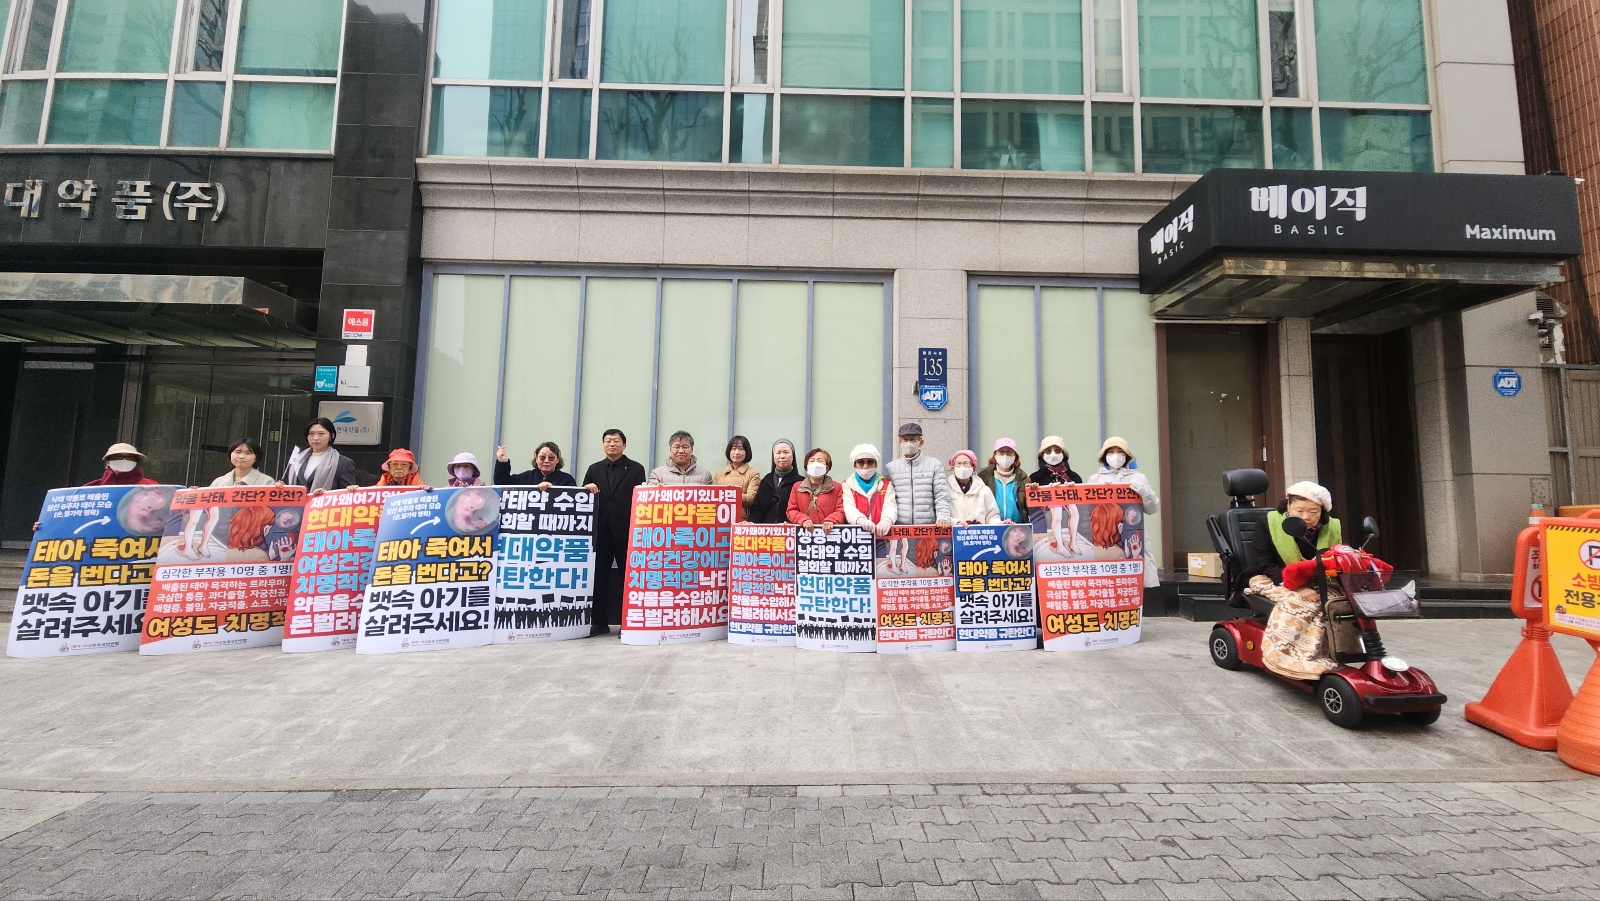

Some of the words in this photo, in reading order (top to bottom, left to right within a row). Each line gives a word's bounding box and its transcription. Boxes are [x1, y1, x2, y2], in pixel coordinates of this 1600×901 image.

[1249, 184, 1367, 221] 베이직
[1150, 204, 1193, 254] 베이직
[1275, 225, 1344, 235] BASIC
[1465, 224, 1556, 241] Maximum
[1158, 241, 1184, 264] BASIC
[348, 318, 369, 326] 에스원
[923, 358, 942, 375] 135
[1498, 378, 1518, 388] ADT
[924, 390, 943, 400] ADT
[176, 494, 197, 505] 약물
[232, 491, 265, 503] 간단?
[269, 490, 303, 502] 안전?
[553, 492, 594, 512] 수입
[637, 490, 737, 502] 제가왜여기있냐면
[1029, 491, 1052, 502] 약물
[1055, 490, 1081, 501] 낙태,
[1085, 489, 1113, 500] 간단?
[1116, 488, 1140, 499] 안전
[307, 506, 383, 530] 현대약
[635, 504, 737, 524] 현대약품이
[499, 513, 535, 530] 회할
[539, 514, 593, 532] 때까지
[894, 528, 911, 536] 낙태,
[913, 527, 932, 536] 간단?
[33, 539, 87, 562] 태아
[376, 538, 421, 562] 태아
[425, 536, 492, 558] 죽여서
[798, 545, 841, 559] 낙태약
[844, 545, 872, 559] 수입
[162, 568, 191, 579] 심각한
[195, 567, 226, 577] 부작용
[231, 567, 254, 575] 10명
[258, 566, 268, 575] 중
[272, 565, 292, 574] 1명!
[372, 566, 413, 587] 돈을
[416, 560, 493, 584] 번다고?
[798, 560, 832, 573] 철회할
[835, 561, 872, 574] 때까지
[958, 561, 989, 576] 태아
[991, 560, 1031, 576] 죽여서
[1044, 565, 1070, 576] 심각한
[1073, 565, 1098, 574] 부작용
[1100, 564, 1117, 573] 10명
[1120, 563, 1126, 573] 중
[1129, 563, 1140, 572] 1명!
[26, 565, 74, 588] 돈을
[497, 566, 588, 590] 탄한다!
[959, 578, 986, 592] 돈을
[988, 577, 1032, 592] 번다고?
[1048, 579, 1071, 589] 배출된
[1072, 579, 1086, 588] 태아
[1116, 577, 1138, 586] 트라우마,
[162, 581, 188, 592] 배출된
[190, 582, 208, 590] 태아
[249, 579, 288, 587] 트라우마,
[799, 575, 871, 595] 현대약품
[157, 593, 184, 602] 극심한
[208, 591, 247, 600] 과다출혈,
[250, 589, 288, 598] 자궁천공,
[369, 590, 414, 612] 뱃속
[420, 586, 490, 608] 아기를
[960, 595, 989, 609] 뱃속
[992, 593, 1033, 608] 아기를
[1046, 590, 1069, 599] 극심한
[1564, 589, 1600, 608] 전용
[21, 592, 76, 615] 뱃속
[208, 600, 248, 610] 자궁적출,
[251, 599, 271, 608] 쇼크,
[800, 596, 871, 613] 규탄한다!
[290, 612, 361, 635] 돈벌려
[365, 610, 489, 637] 살려주세요!
[880, 612, 916, 627] 여성도
[920, 611, 954, 625] 치명적
[960, 609, 1033, 624] 살려주세요!
[1046, 613, 1100, 634] 여성도
[1104, 608, 1141, 631] 치명적
[148, 615, 218, 637] 여성도
[730, 622, 763, 633] 현대약품
[959, 629, 998, 639] 현대약품
[999, 626, 1035, 638] 규탄한다
[880, 629, 917, 641] 현대약품
[919, 628, 954, 638] 규탄한다
